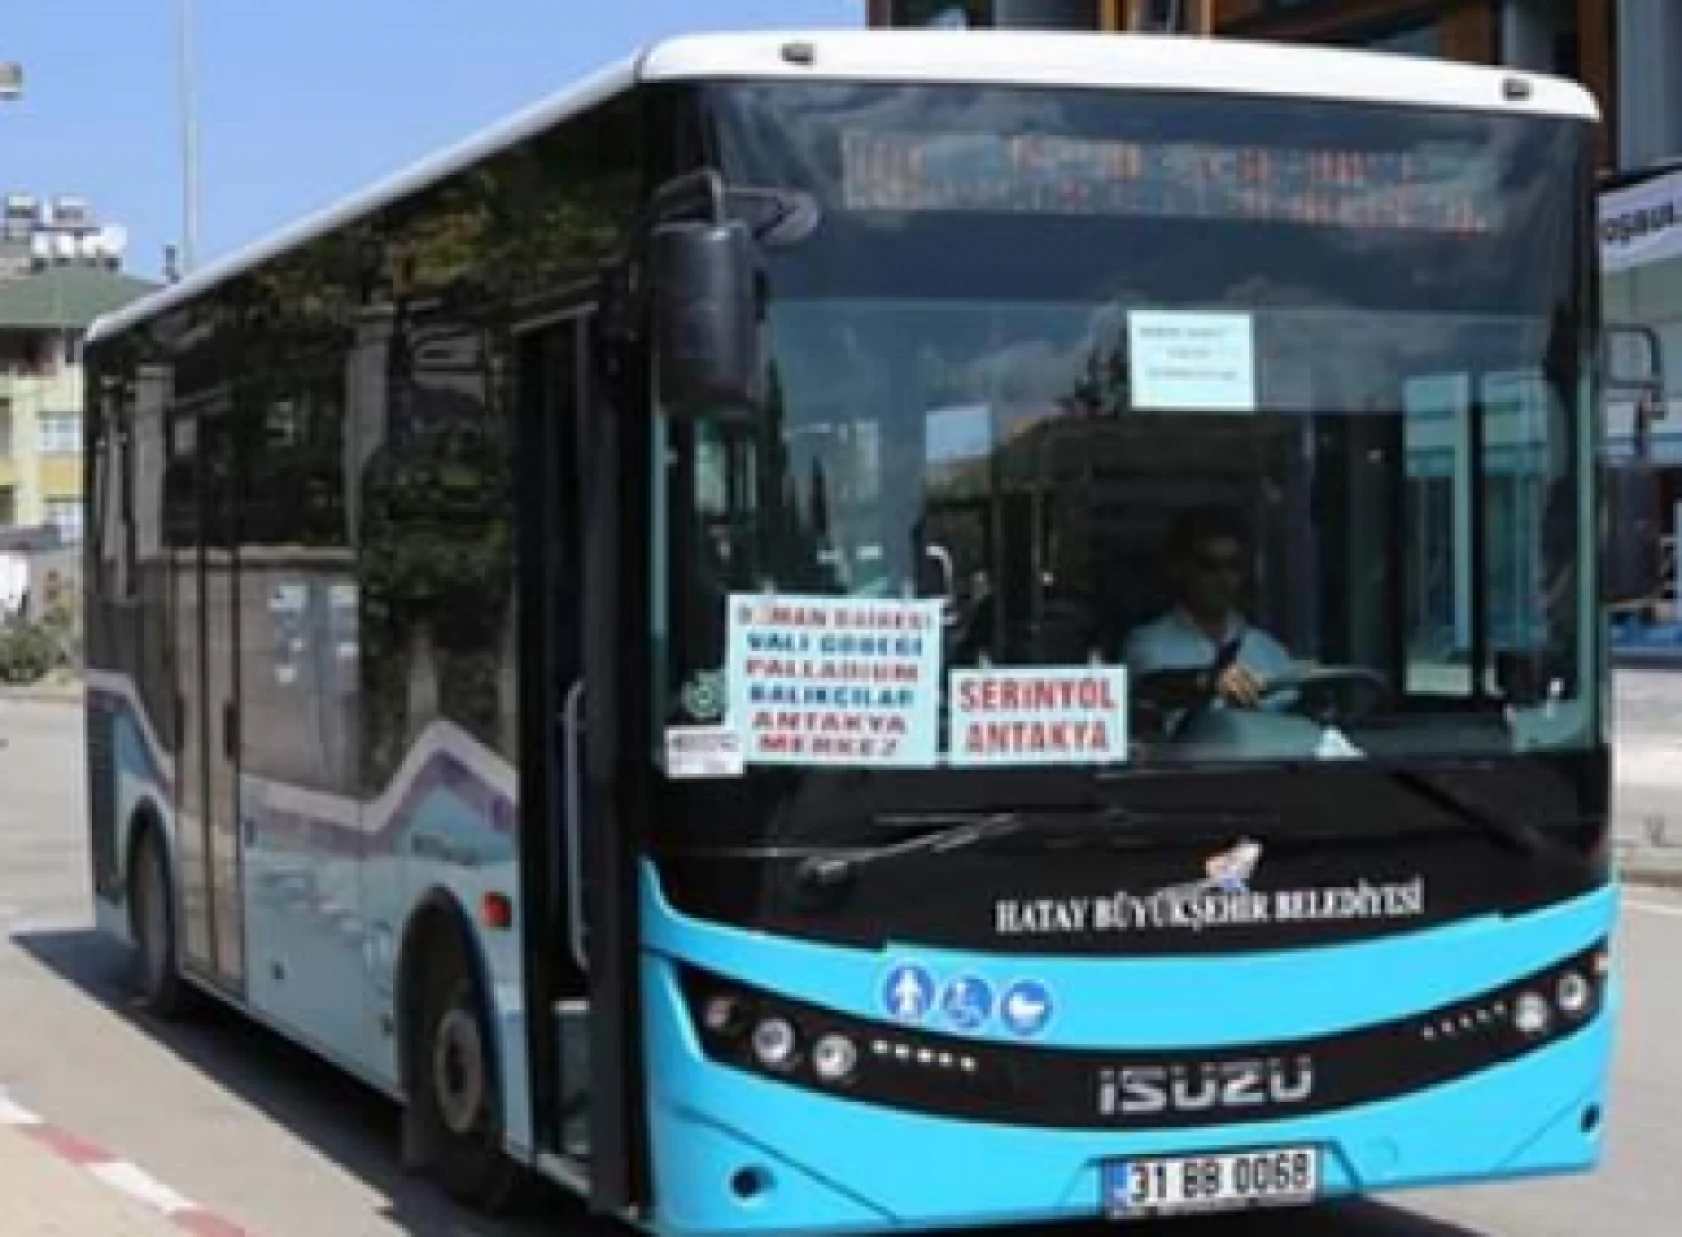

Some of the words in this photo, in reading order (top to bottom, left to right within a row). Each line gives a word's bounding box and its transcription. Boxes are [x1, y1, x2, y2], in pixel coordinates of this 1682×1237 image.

[752, 711, 906, 734] ANTAKYA
[966, 721, 1108, 753] ANTAKYA
[760, 733, 898, 756] MERKEZ
[997, 898, 1089, 932] HATAY
[1131, 1163, 1167, 1203] 31
